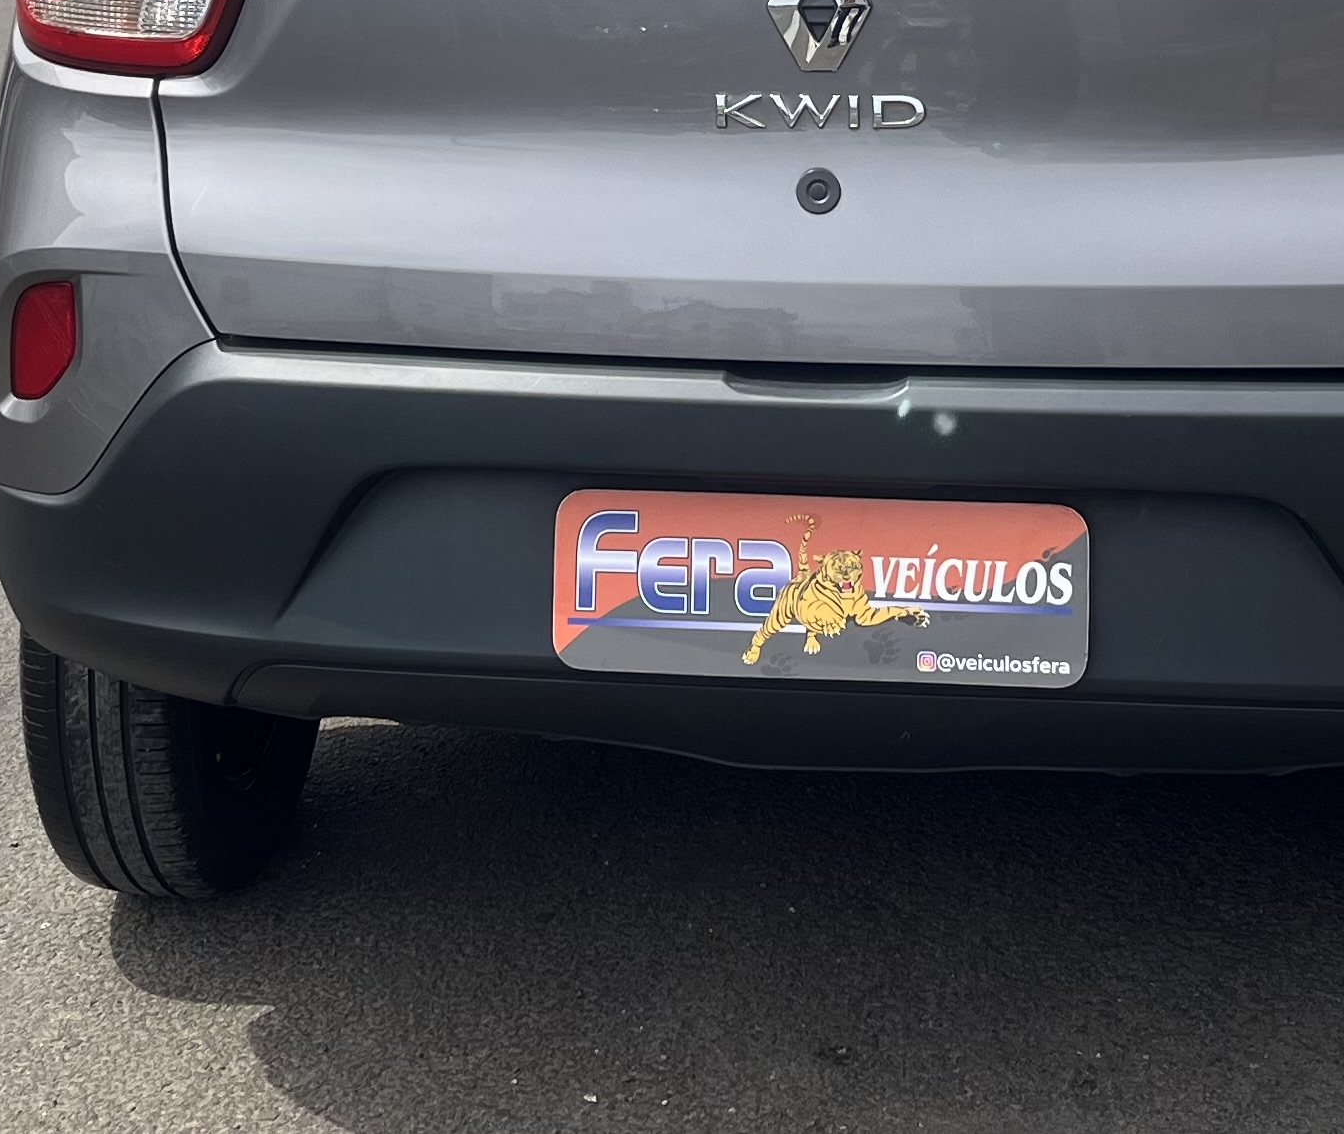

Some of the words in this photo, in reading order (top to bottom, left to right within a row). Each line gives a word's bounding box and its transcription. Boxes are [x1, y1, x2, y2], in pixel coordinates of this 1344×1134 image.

[715, 93, 926, 129] KWID
[575, 509, 794, 616] Fera
[870, 544, 1074, 606] VEÍCULOS
[937, 653, 1071, 676] @veiculosfera
